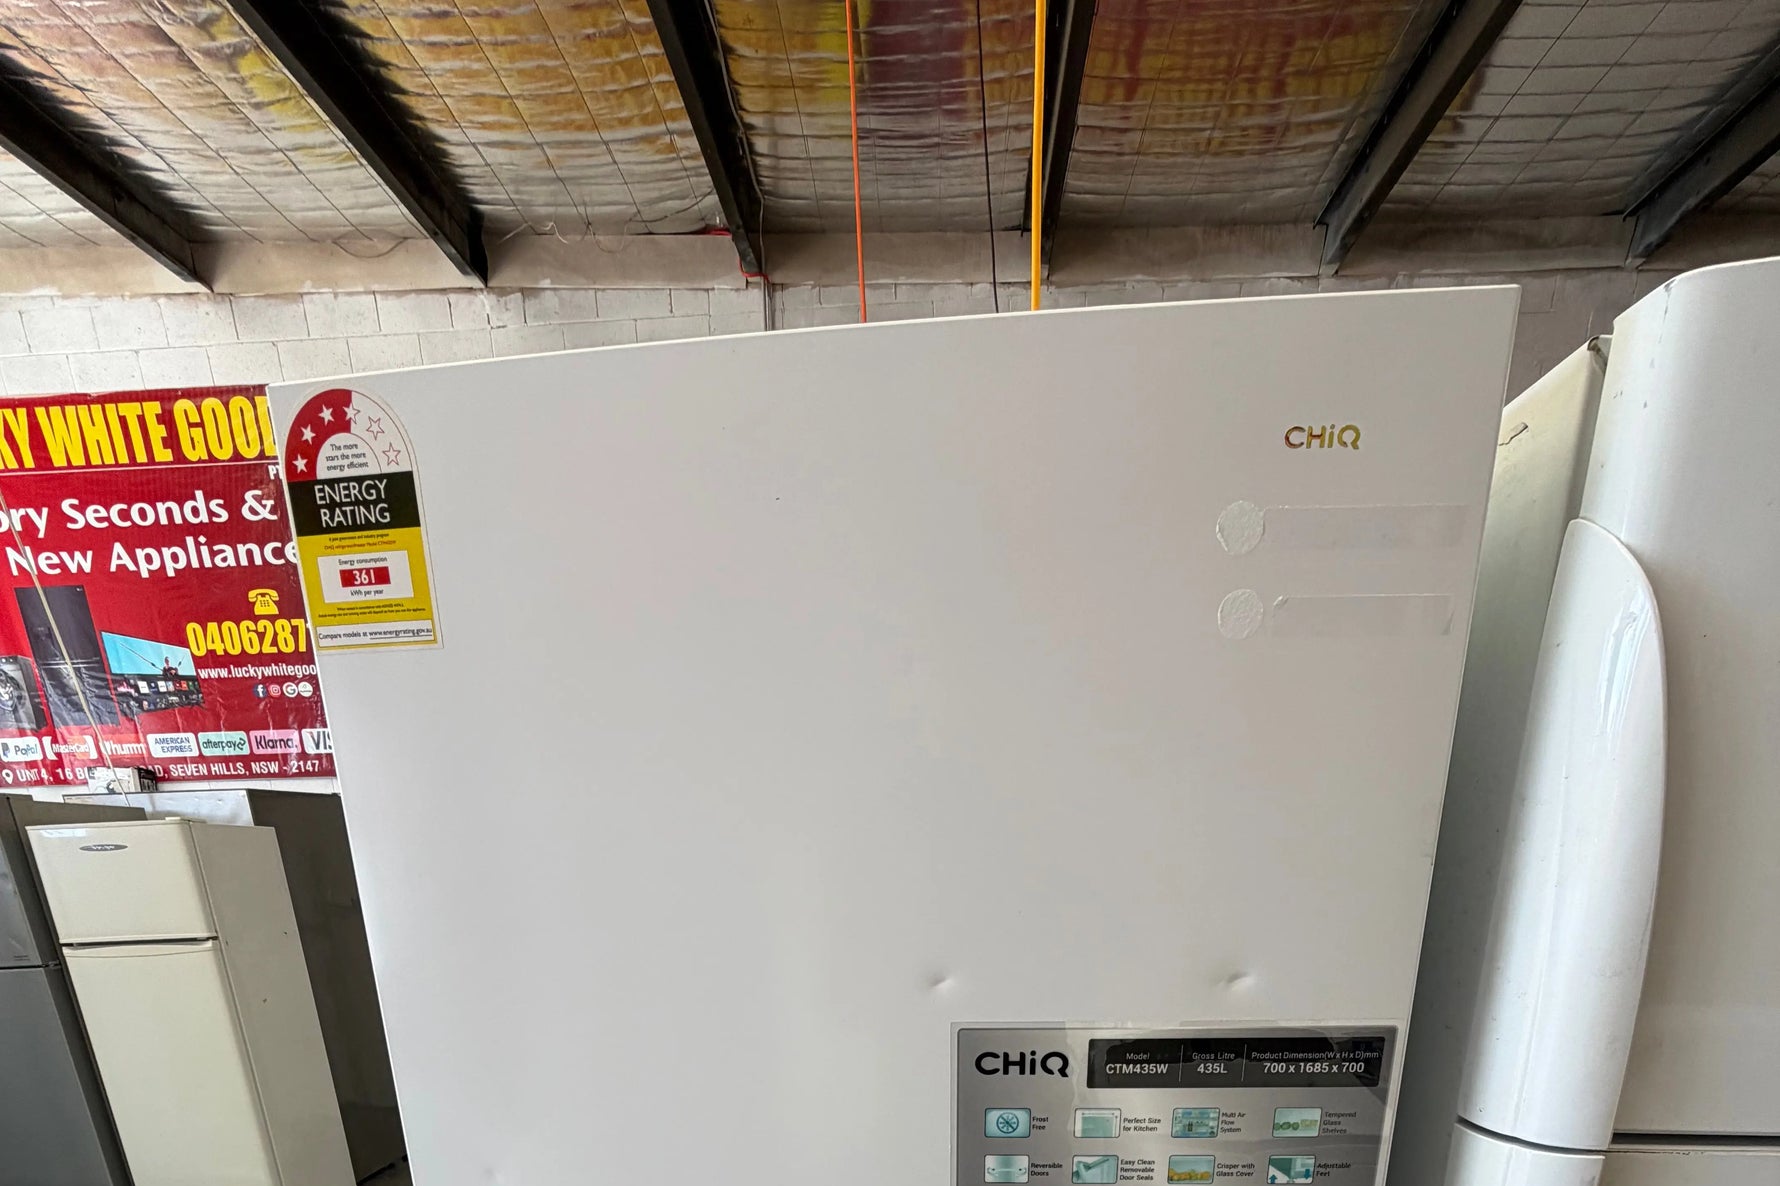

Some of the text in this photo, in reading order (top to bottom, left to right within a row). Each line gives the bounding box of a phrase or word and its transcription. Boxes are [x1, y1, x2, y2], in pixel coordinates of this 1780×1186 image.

[34, 401, 173, 467] WHITE
[327, 461, 369, 472] energy efficient
[315, 479, 388, 504] ENERGY
[61, 490, 229, 530] Seconds
[241, 489, 278, 521] &
[320, 503, 391, 528] RATING
[7, 544, 92, 577] New
[338, 556, 387, 566] Energy consumption
[353, 570, 375, 585] 361
[186, 619, 306, 656] 0406287
[318, 632, 342, 640] Compare
[343, 630, 361, 638] models
[198, 663, 317, 679] www.luckywhitegoo
[154, 737, 190, 745] AMERICAN
[202, 739, 236, 755] afterpay
[14, 743, 38, 756] PayPal
[161, 745, 192, 753] EXPRESS
[56, 768, 73, 780] 16
[170, 762, 208, 776] SEVEN
[210, 762, 249, 776] HILLS,
[251, 761, 279, 773] NSW
[291, 760, 319, 773] 2147
[1126, 1052, 1150, 1060] Model
[1192, 1052, 1235, 1060] Gross Litre
[974, 1049, 1070, 1078] CHiQ
[1106, 1063, 1168, 1074] CTM435W
[1197, 1063, 1228, 1074] 435L
[1263, 1062, 1364, 1073] 700 x 1685 x 700
